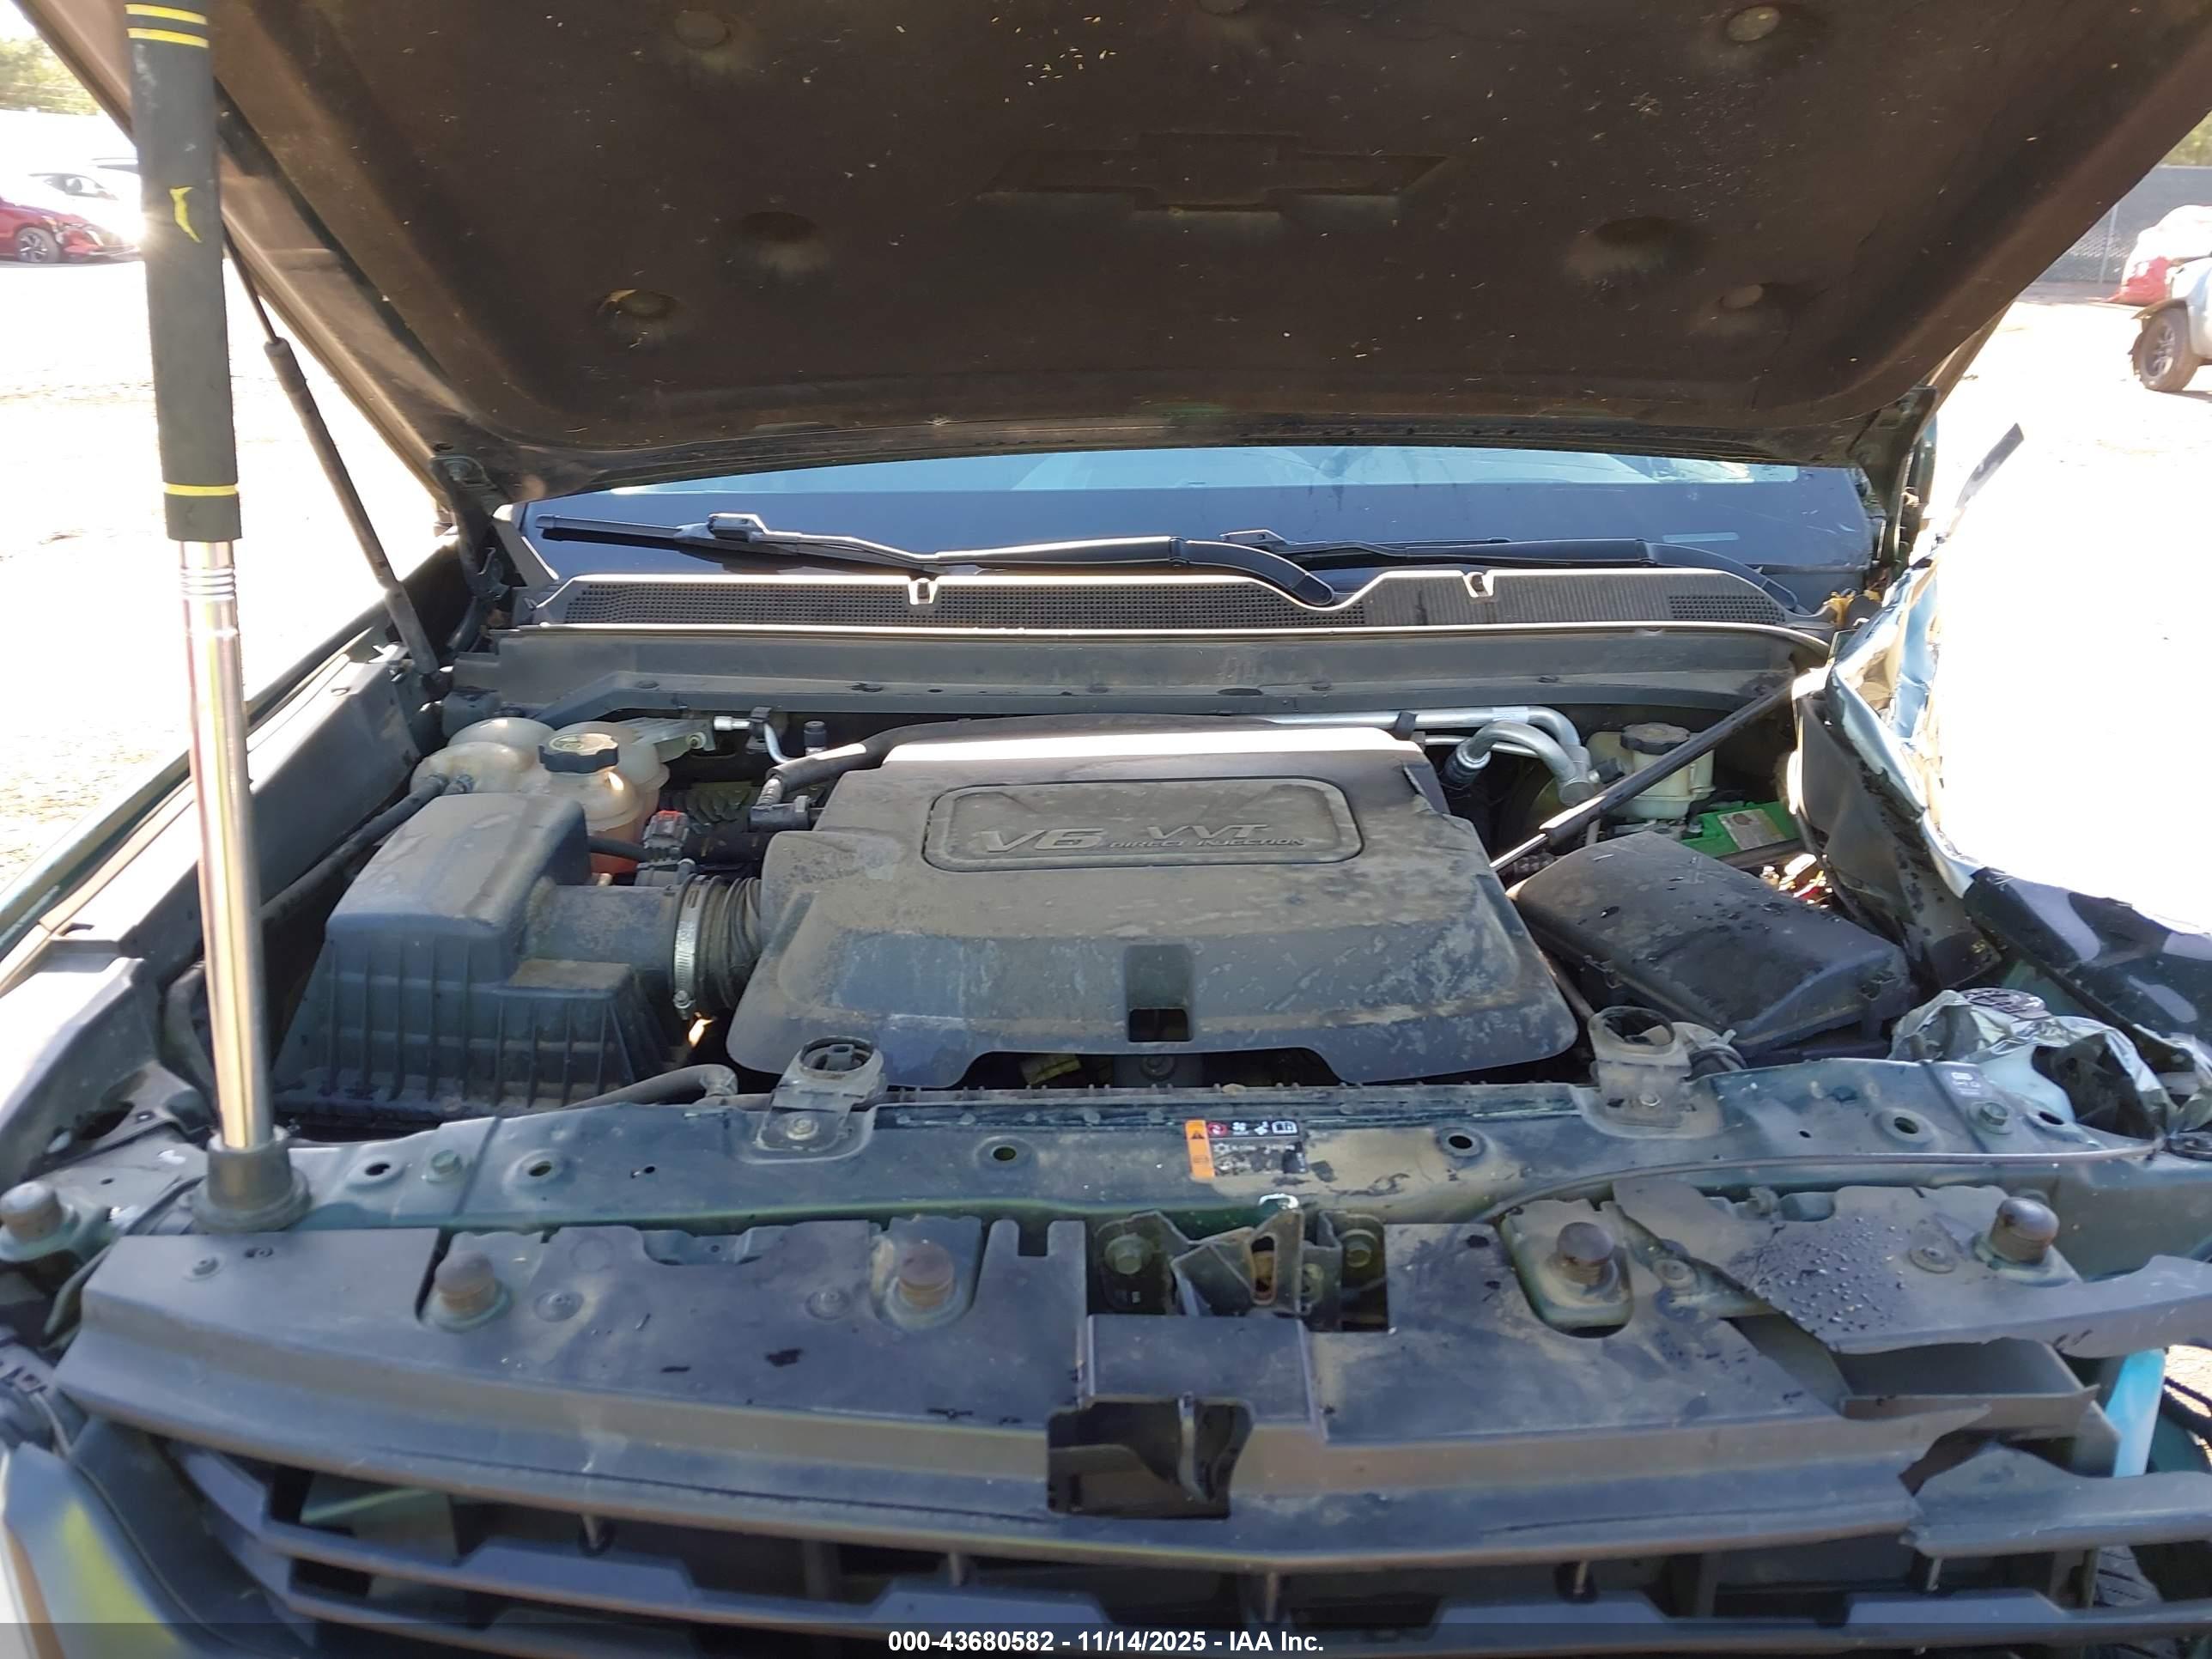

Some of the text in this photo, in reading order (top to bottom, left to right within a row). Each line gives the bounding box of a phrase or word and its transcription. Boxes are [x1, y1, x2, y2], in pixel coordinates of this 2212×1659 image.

[1146, 824, 1269, 839] VVT
[981, 829, 1103, 852] V6
[1109, 838, 1305, 848] DIRECT INJECTION
